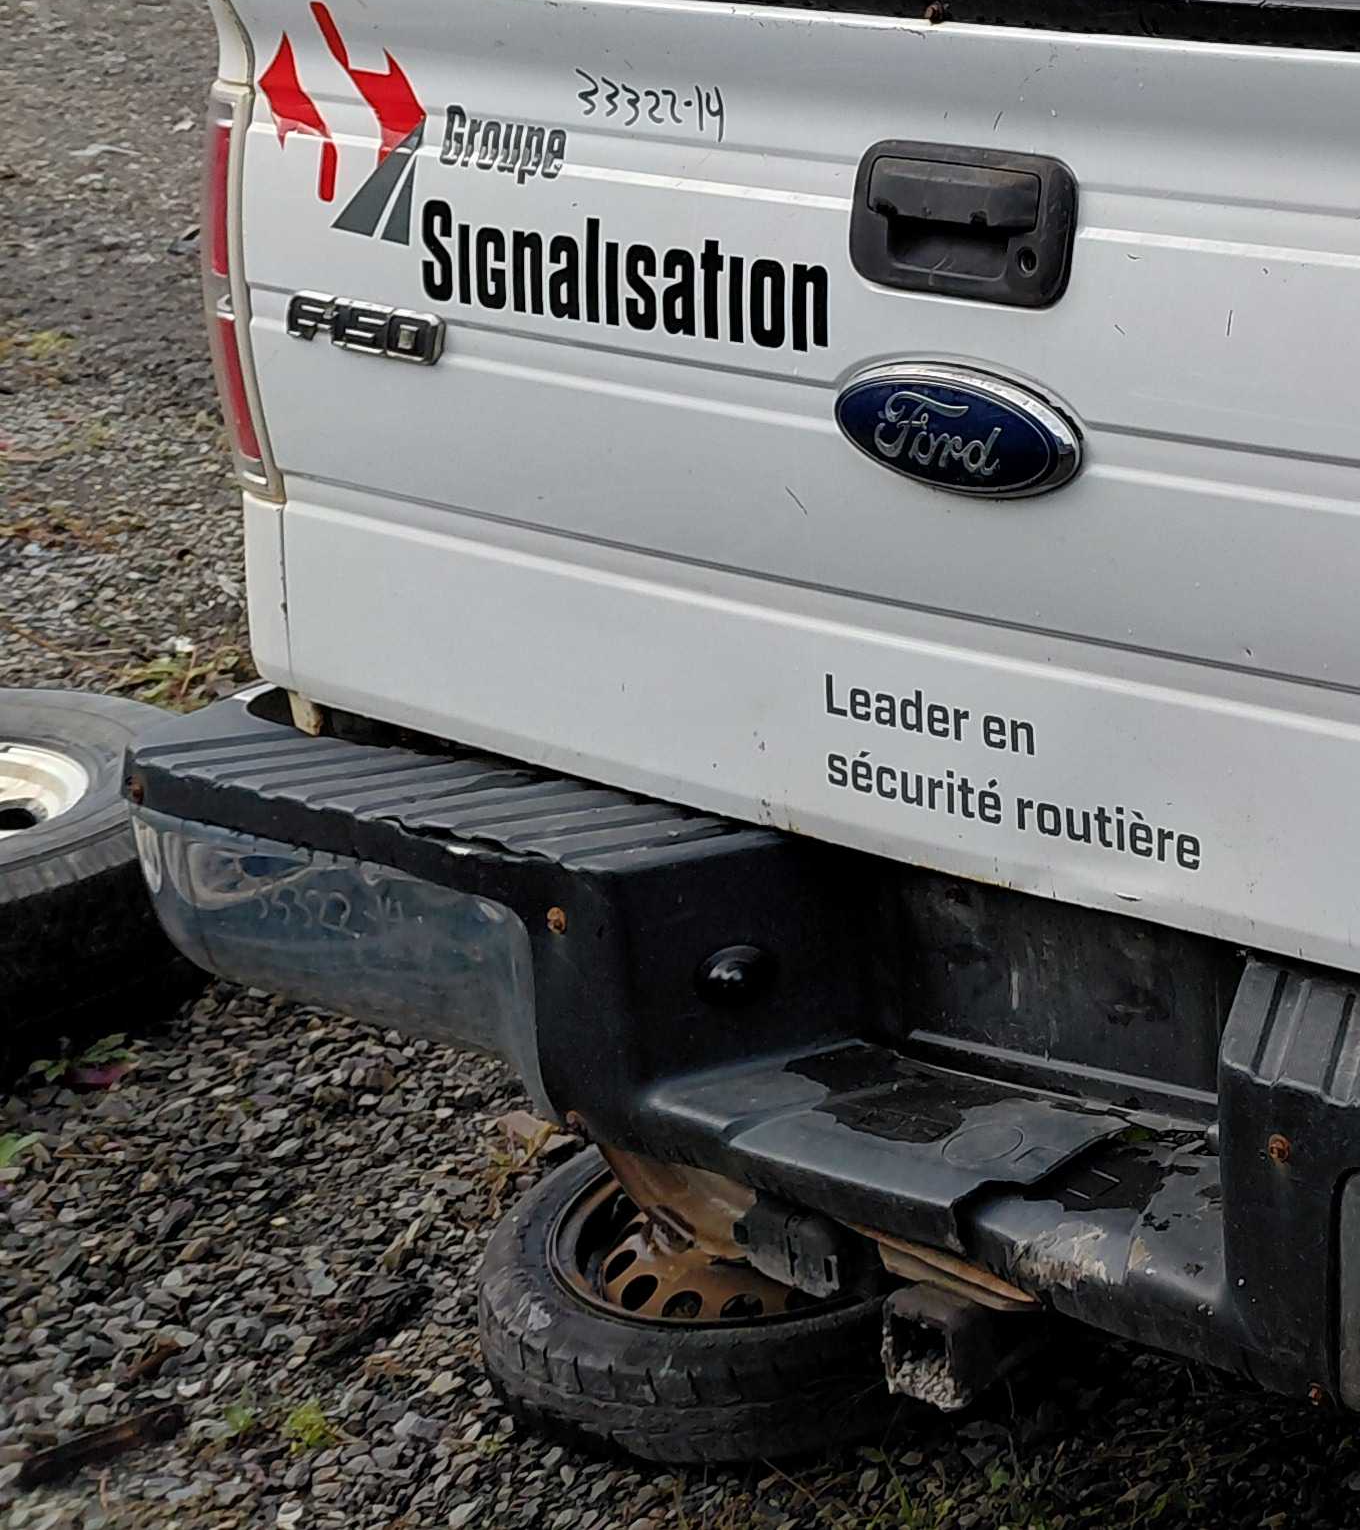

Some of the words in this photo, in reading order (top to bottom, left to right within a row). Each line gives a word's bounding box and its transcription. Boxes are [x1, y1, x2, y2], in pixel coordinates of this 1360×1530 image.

[440, 104, 568, 185] Groupe
[576, 68, 724, 142] 33322-14
[421, 198, 830, 352] Signalisation
[874, 391, 1002, 476] Ford
[824, 673, 970, 741] Leader
[982, 712, 1035, 756] en
[826, 751, 1002, 824] sécurité
[1016, 796, 1201, 871] routière
